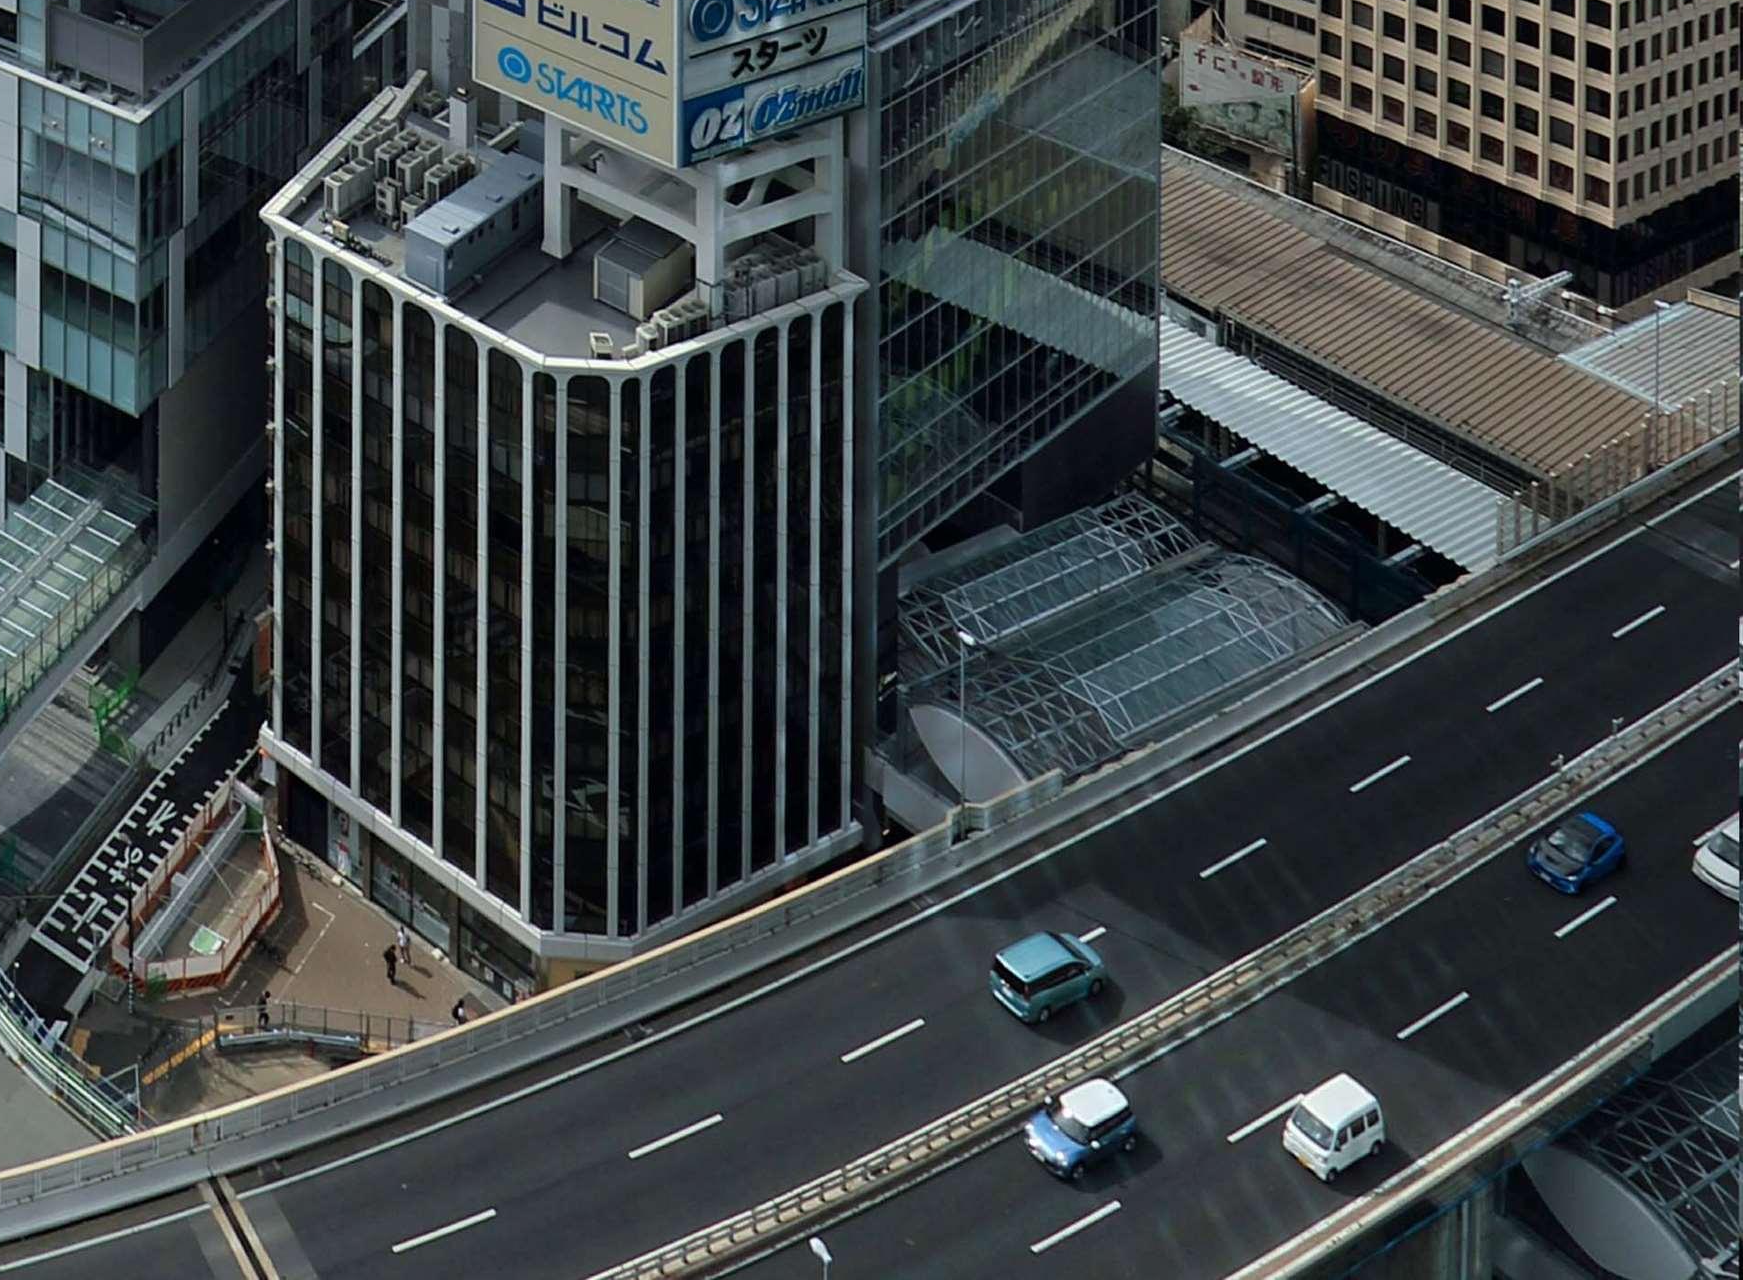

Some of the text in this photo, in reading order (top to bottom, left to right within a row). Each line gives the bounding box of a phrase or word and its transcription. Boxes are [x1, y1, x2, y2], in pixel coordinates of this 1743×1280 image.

[731, 25, 828, 79] スターツ
[536, 62, 648, 135] STARTS
[690, 99, 744, 150] OZ
